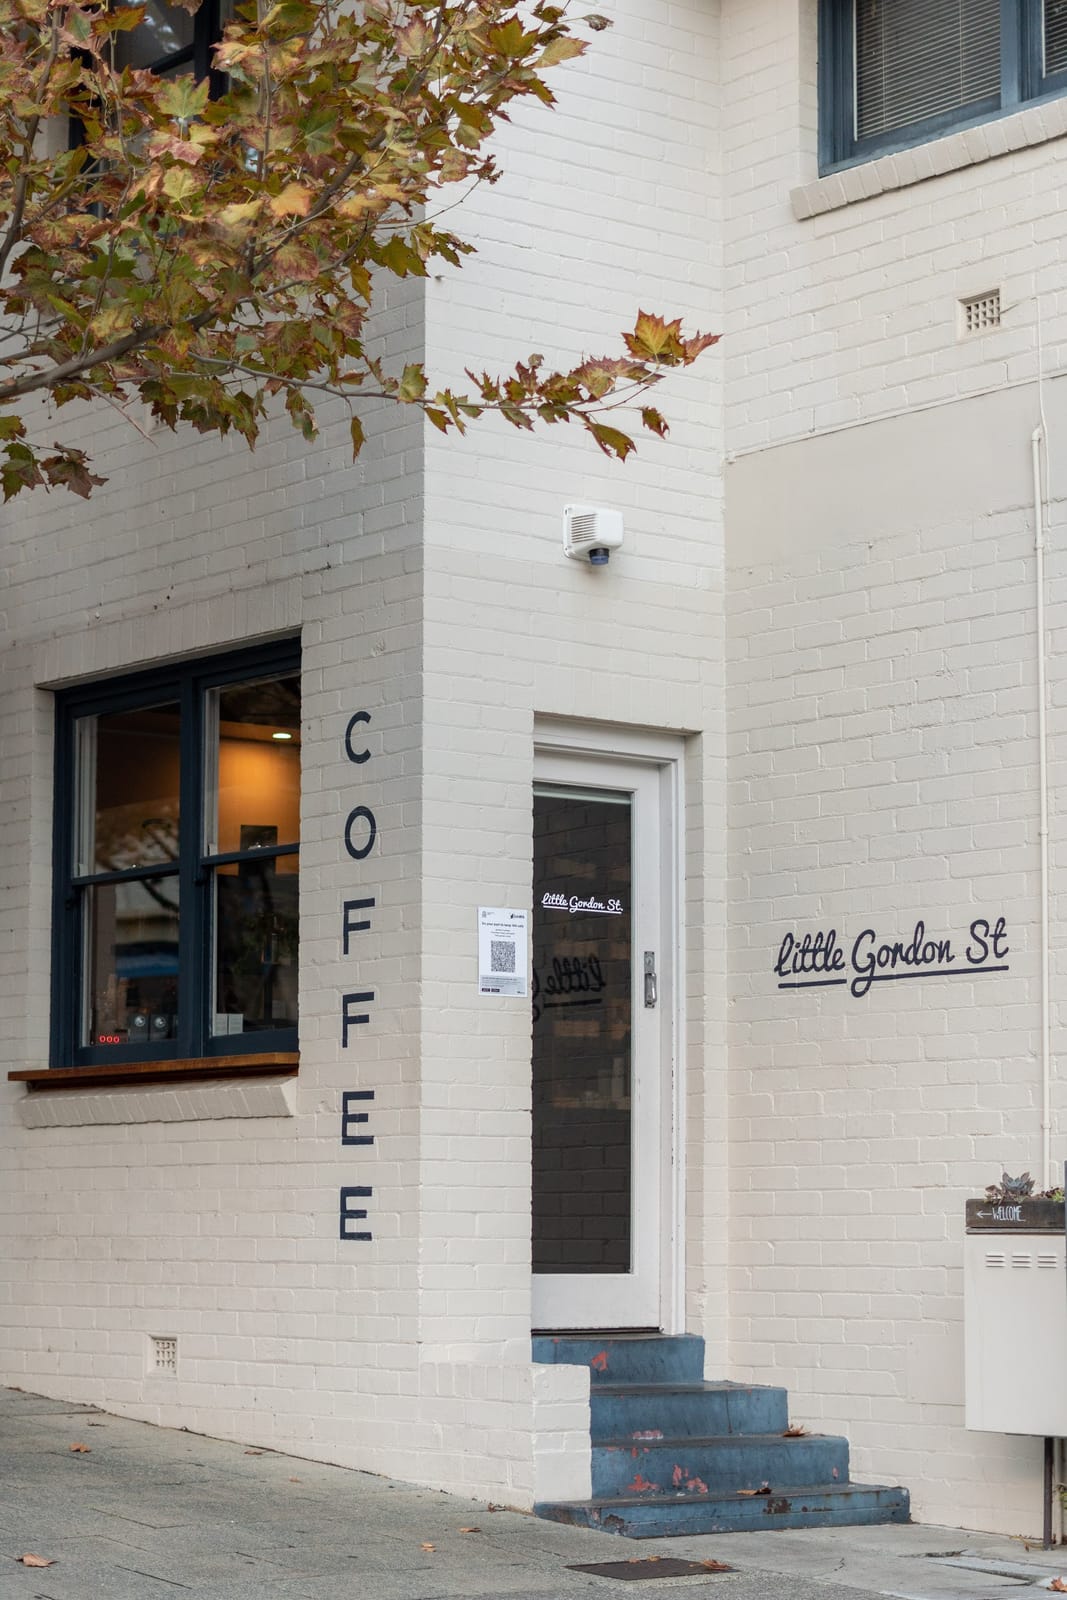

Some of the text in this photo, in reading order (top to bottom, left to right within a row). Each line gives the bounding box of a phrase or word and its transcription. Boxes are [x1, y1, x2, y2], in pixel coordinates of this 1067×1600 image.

[569, 895, 606, 914] Gordon
[340, 710, 377, 1242] COFFEE
[851, 919, 956, 999] Gordon
[965, 916, 1010, 966] St
[992, 1205, 1026, 1222] WELCOME
